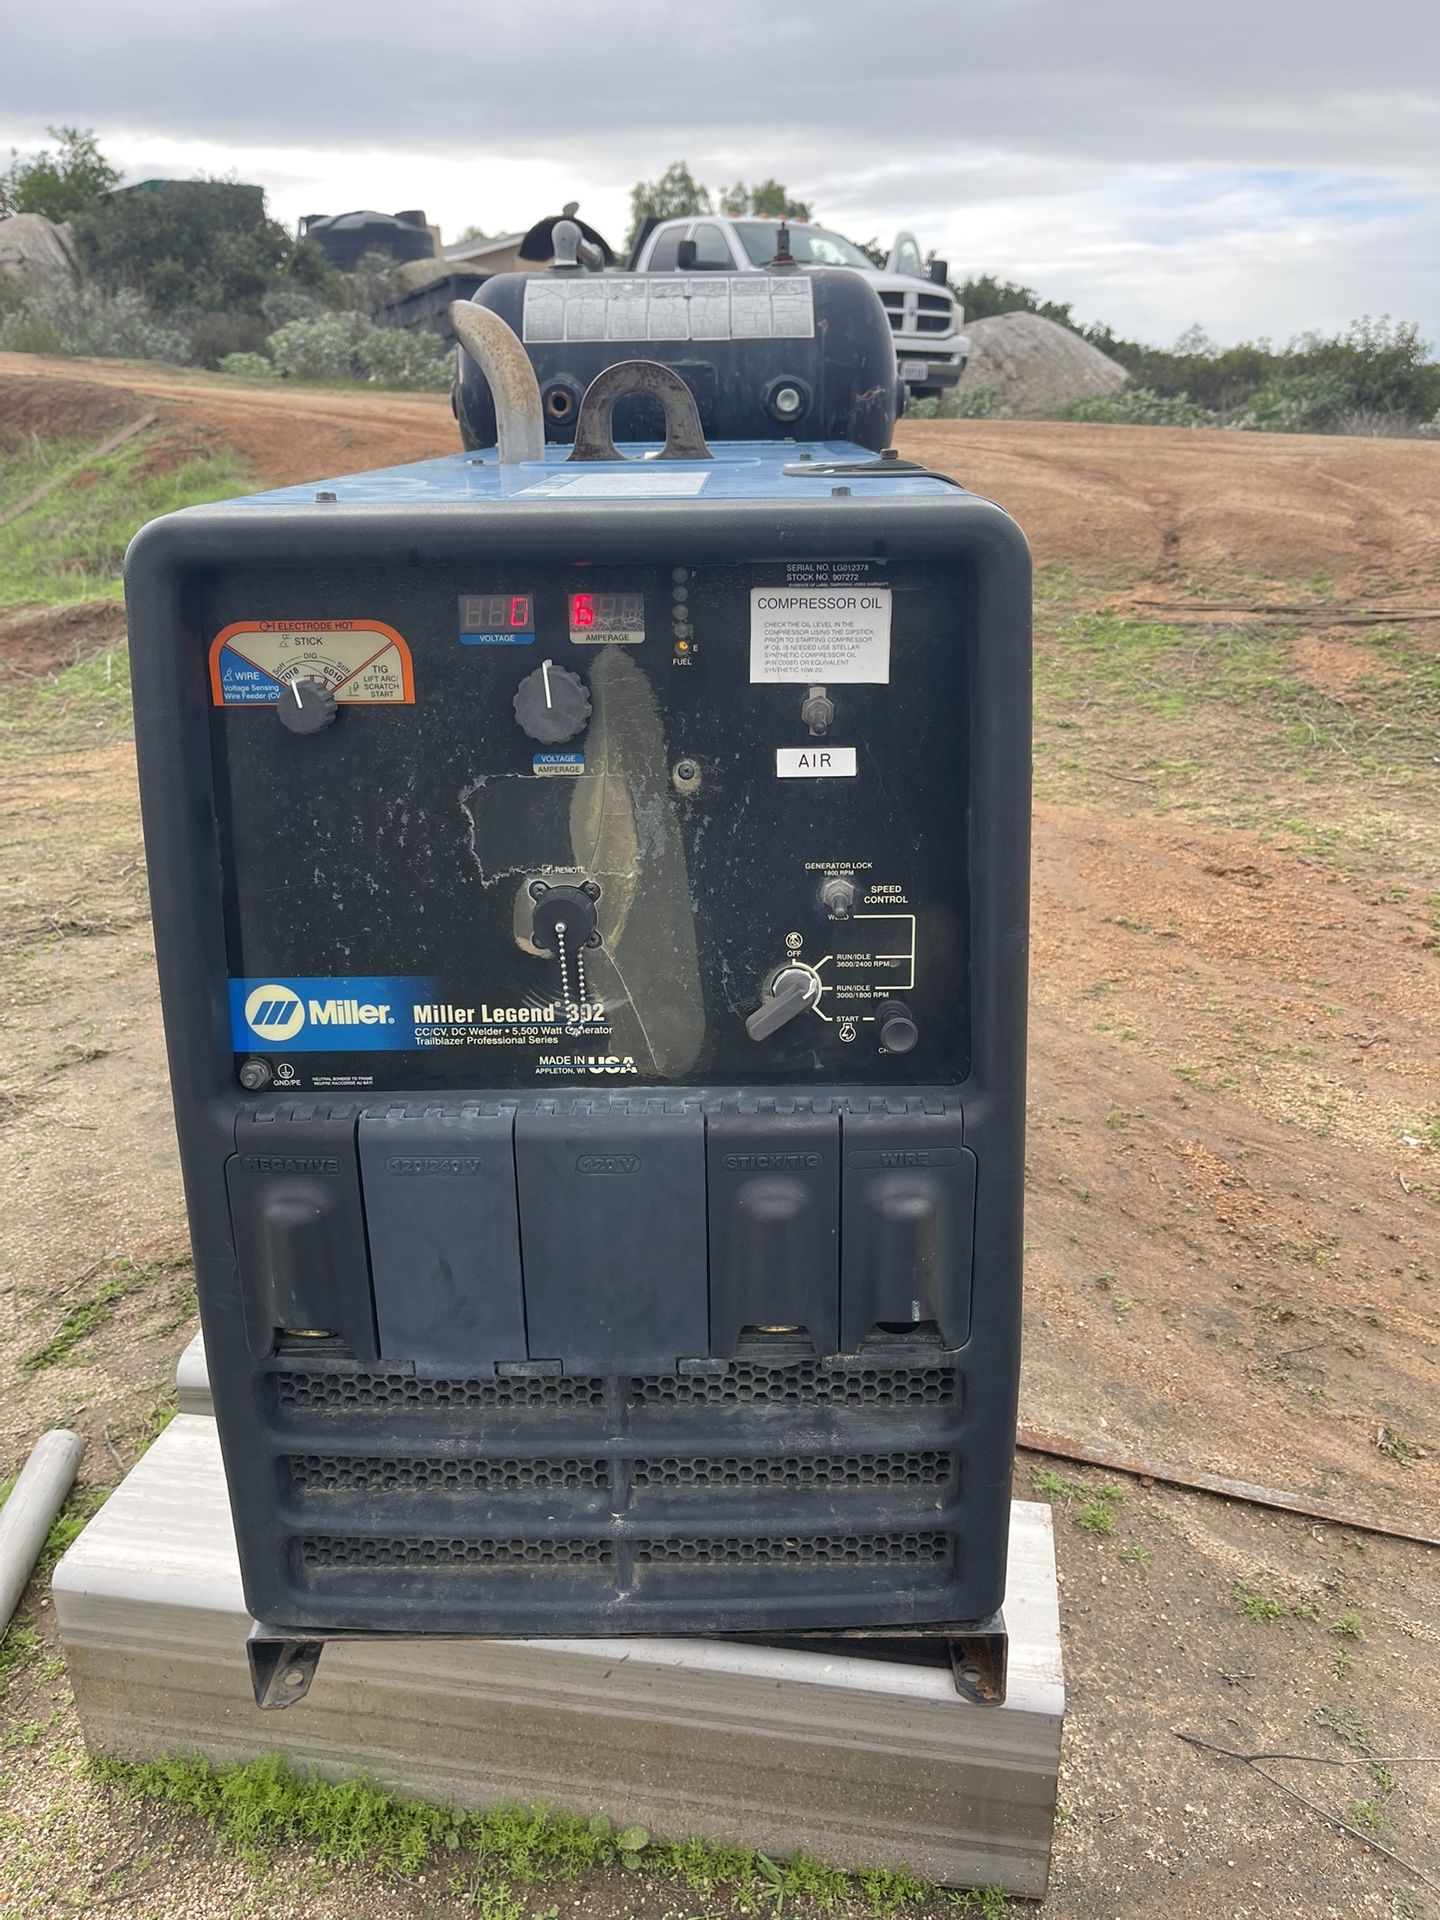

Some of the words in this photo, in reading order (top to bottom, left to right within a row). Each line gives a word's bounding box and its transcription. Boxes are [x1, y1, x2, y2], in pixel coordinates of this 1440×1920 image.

[786, 564, 814, 572] SERIAL
[832, 564, 869, 572] LG012378
[691, 571, 697, 579] F
[786, 573, 814, 581] STOCK
[816, 573, 830, 581] NO.
[832, 573, 859, 581] 907272
[758, 597, 857, 610] COMPRESSOR
[860, 597, 883, 609] OIL
[278, 622, 332, 630] ELECTRODE
[335, 622, 354, 630] HOT
[295, 637, 323, 646] STICK
[479, 634, 515, 642] VOLTAGE
[586, 633, 629, 641] AMPERAGE
[273, 662, 286, 675] Soft
[336, 661, 351, 674] Stiff
[372, 665, 388, 673] TIG
[235, 672, 260, 680] WIRE
[281, 666, 299, 682] 7018
[323, 666, 343, 682] 6010
[224, 684, 250, 693] Voltage
[251, 683, 279, 693] Sensing
[225, 692, 242, 700] Wire
[242, 692, 266, 700] Feeder
[268, 692, 281, 701] (CV
[541, 755, 576, 763] VOLTAGE
[798, 753, 832, 768] AIR
[538, 765, 580, 773] AMPERAGE
[871, 885, 902, 893] SPEED
[864, 896, 908, 904] CONTROL
[413, 1004, 475, 1024] Miller
[567, 1003, 605, 1022] 302
[415, 1028, 449, 1037] CC/CV,
[451, 1027, 467, 1036] DC
[468, 1027, 503, 1036] Welder
[512, 1027, 539, 1036] 5,500
[541, 1026, 564, 1035] Watt
[415, 1037, 464, 1046] Trailblazer
[467, 1036, 526, 1045] Professional
[528, 1036, 558, 1044] Series
[539, 1056, 571, 1065] MADE
[574, 1056, 585, 1064] IN
[588, 1056, 638, 1074] USA
[535, 1067, 575, 1075] APPLETON,
[273, 1079, 302, 1087] GND/PE
[727, 1154, 820, 1169] STICK/TIG
[881, 1152, 929, 1166] WIRE
[246, 1157, 340, 1173] NEGATIVE
[390, 1157, 462, 1173] 120/240
[464, 1157, 482, 1172] V
[583, 1157, 616, 1172] 120
[618, 1157, 635, 1172] V
